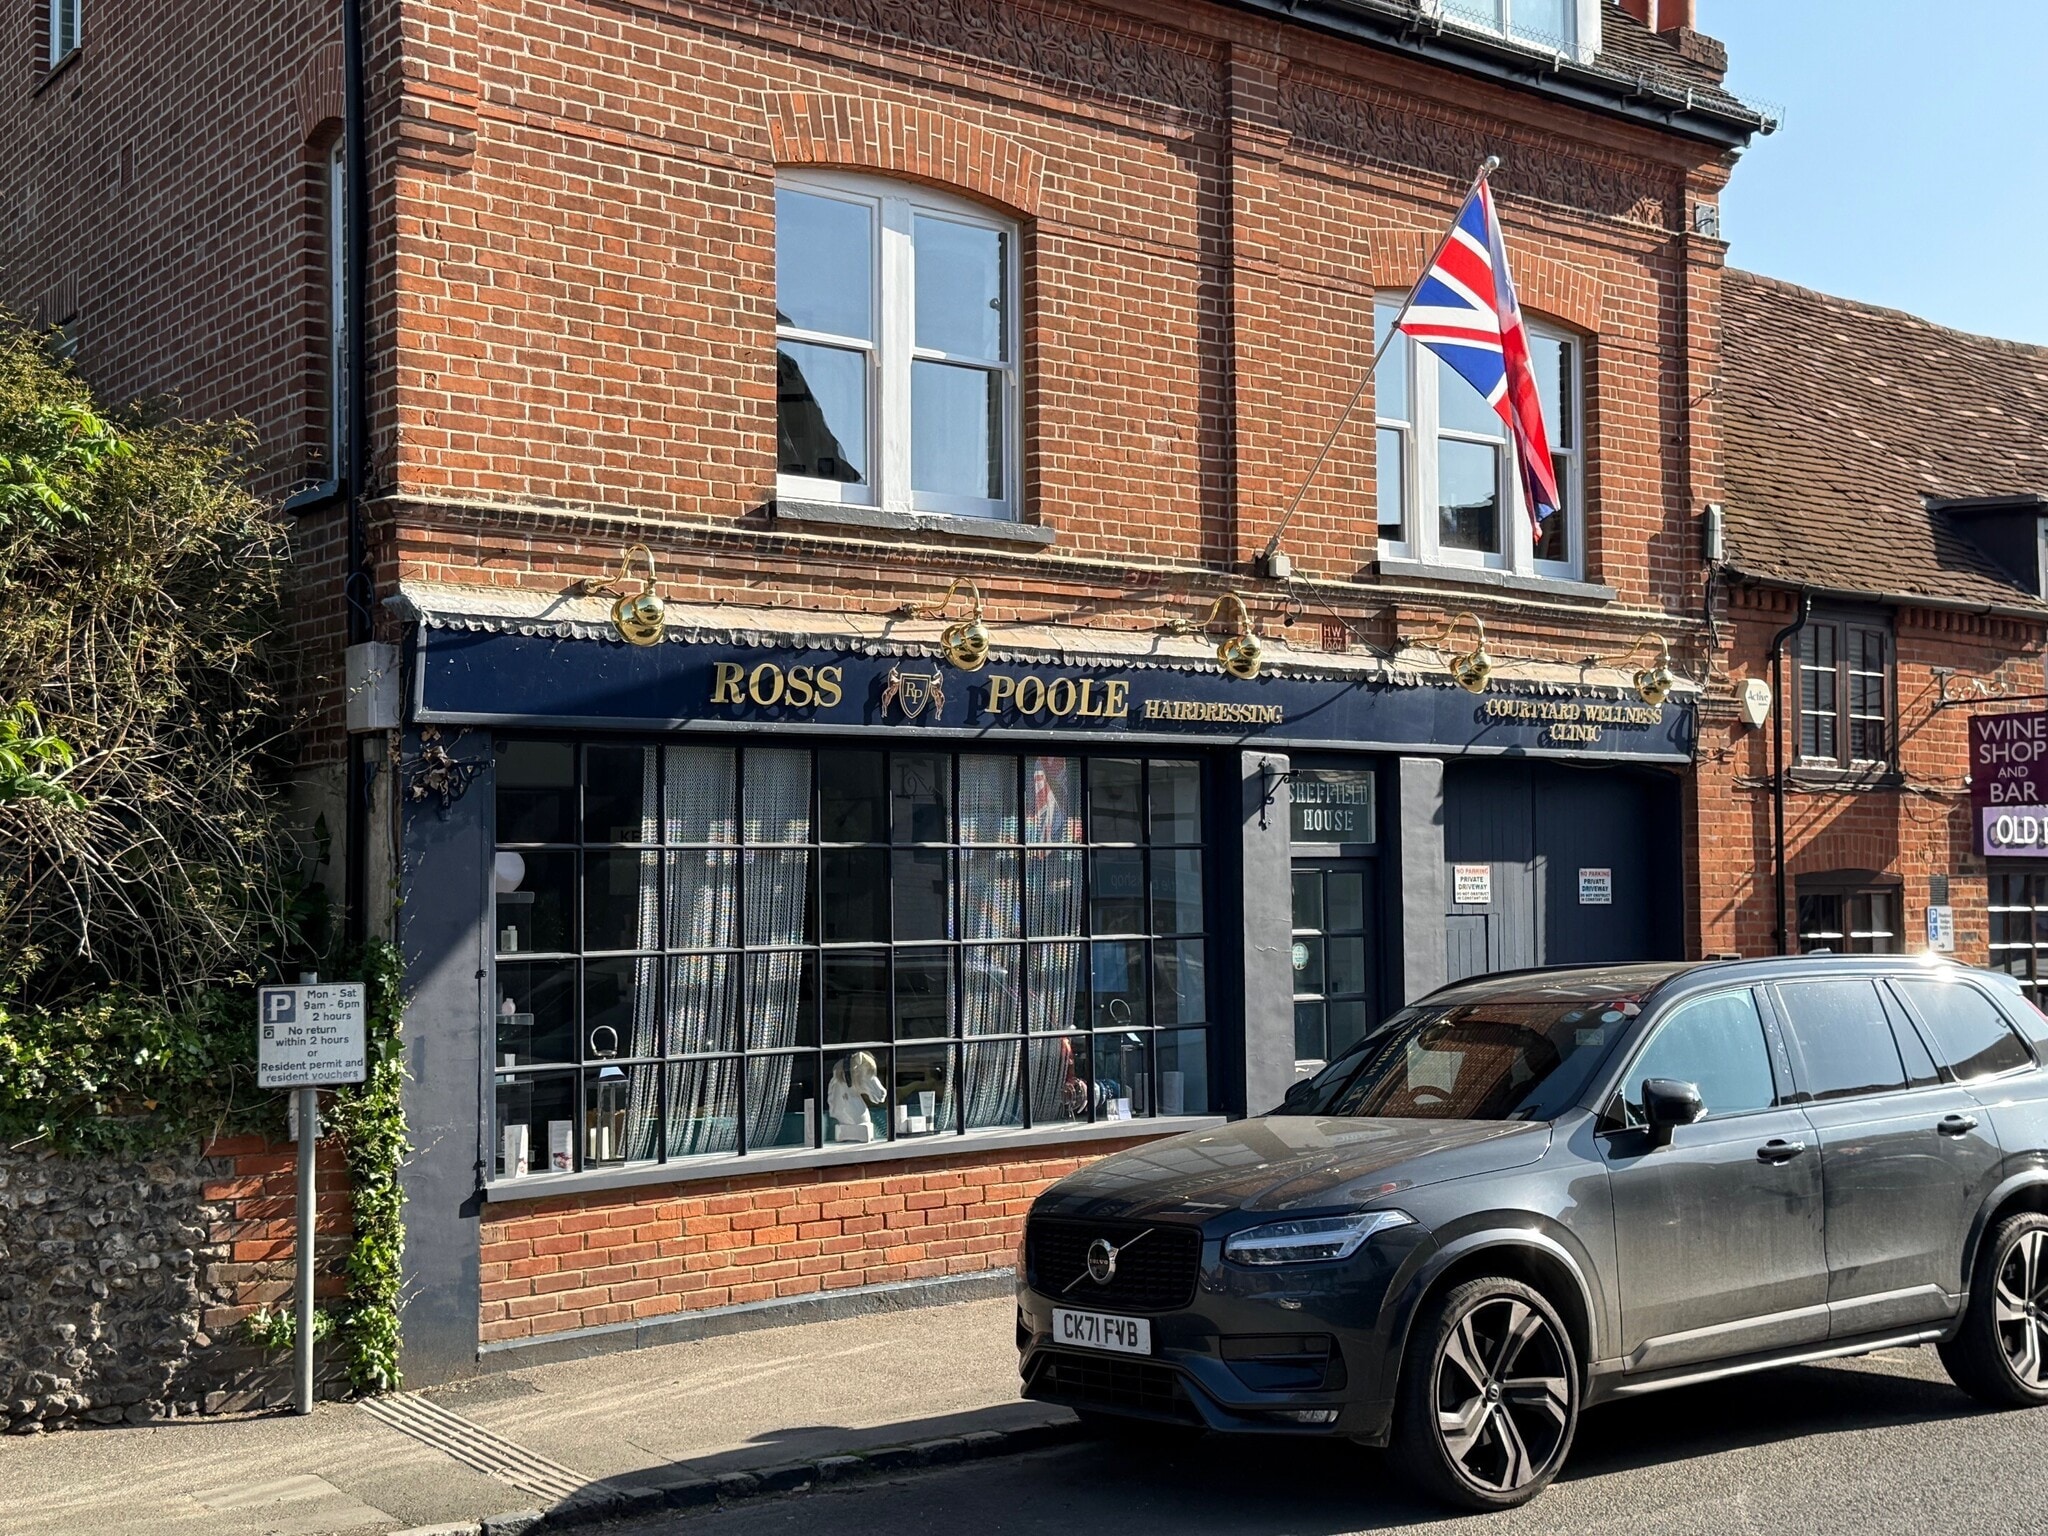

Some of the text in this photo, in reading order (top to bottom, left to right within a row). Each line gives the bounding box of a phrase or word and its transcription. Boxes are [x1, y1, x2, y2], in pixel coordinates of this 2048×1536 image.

[710, 661, 1283, 724] ROSS POOLE HAIRDRESSING
[905, 682, 923, 705] RP
[1486, 699, 1662, 724] COURTYARD WELLNESS
[1550, 723, 1602, 742] CLINIC
[1977, 717, 2047, 741] WINE
[1979, 740, 2047, 764] SHOP
[1997, 766, 2029, 779] AND
[1289, 782, 1368, 805] SHEFFIELD
[1990, 781, 2039, 803] BAR
[1303, 809, 1354, 831] HOUSE
[1997, 814, 2039, 845] OLD
[307, 990, 328, 999] Mon
[339, 989, 357, 998] Sat
[303, 1001, 326, 1010] 9am
[337, 1000, 360, 1010] 6pm
[312, 1011, 351, 1021] 2 hours
[288, 1025, 337, 1035] No return
[275, 1035, 350, 1047] within 2 hours
[261, 1058, 364, 1072] Resident permit and
[266, 1069, 358, 1082] resident vouchers
